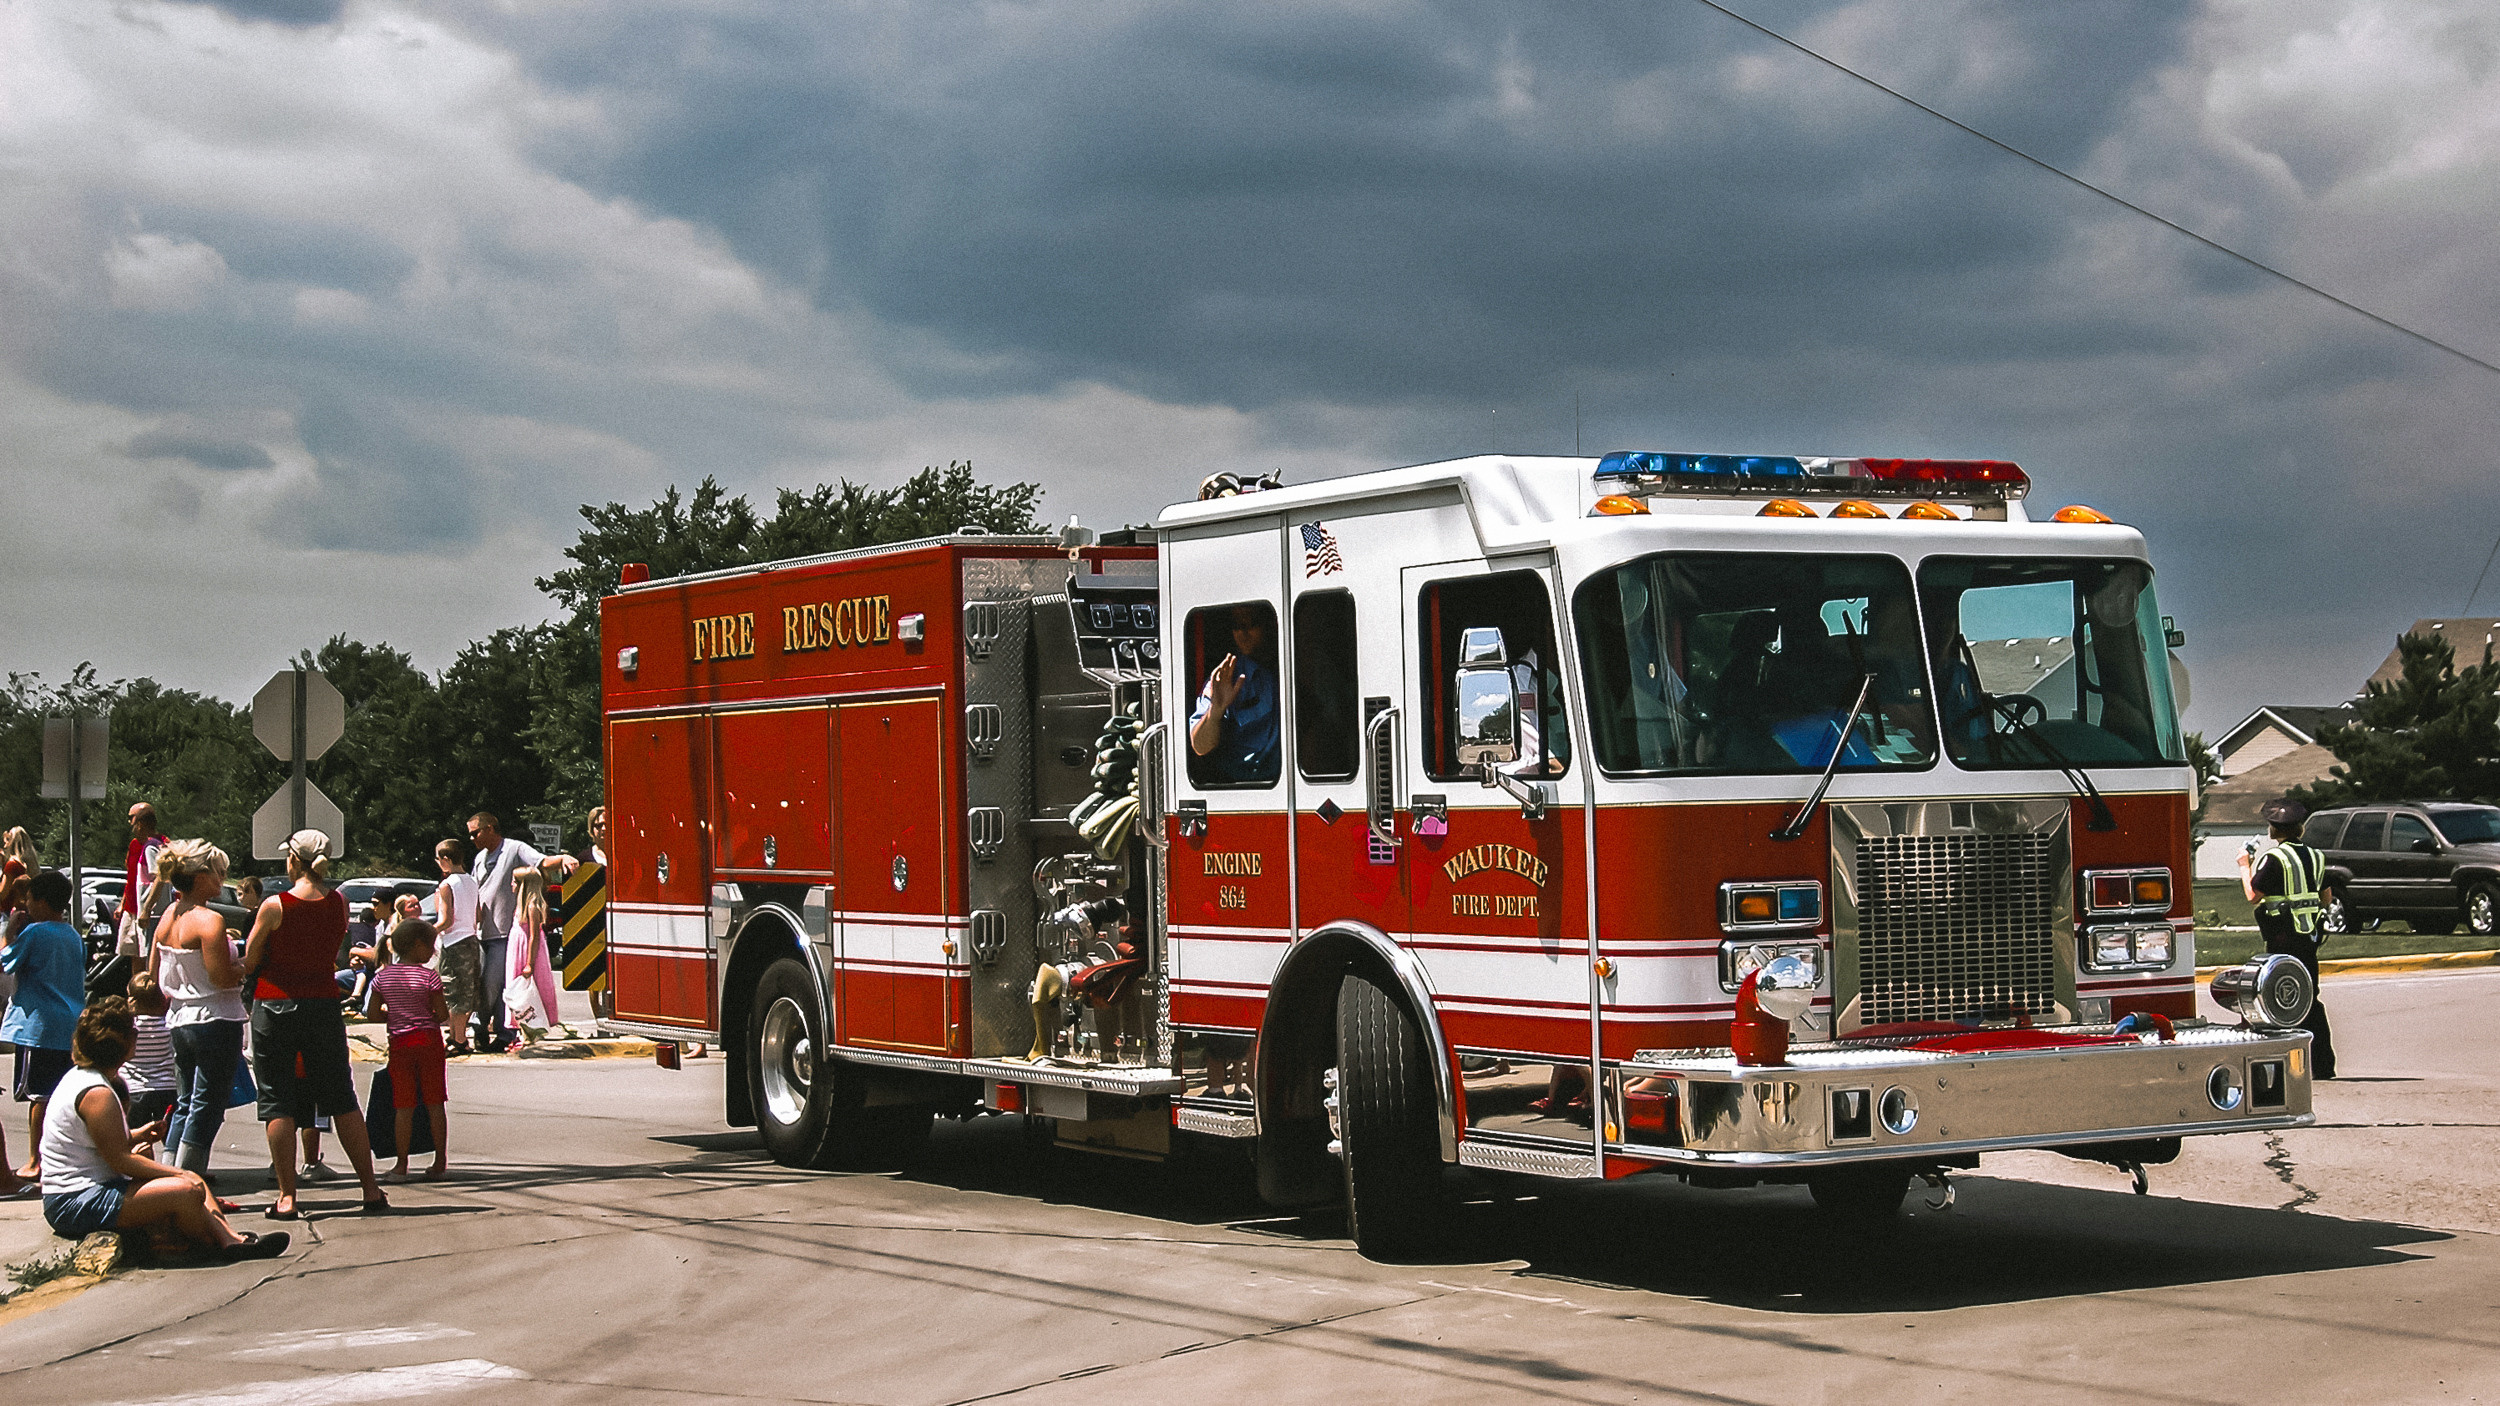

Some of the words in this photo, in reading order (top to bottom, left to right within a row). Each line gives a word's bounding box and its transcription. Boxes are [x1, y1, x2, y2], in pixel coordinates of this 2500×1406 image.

[693, 612, 755, 661] FIRE
[783, 594, 890, 651] RESCUE
[1203, 852, 1262, 875] ENGINE
[1443, 843, 1548, 888] WAUKEE
[1219, 884, 1246, 909] 864
[1452, 894, 1490, 916] FIRE
[1494, 895, 1540, 917] DEPT.
